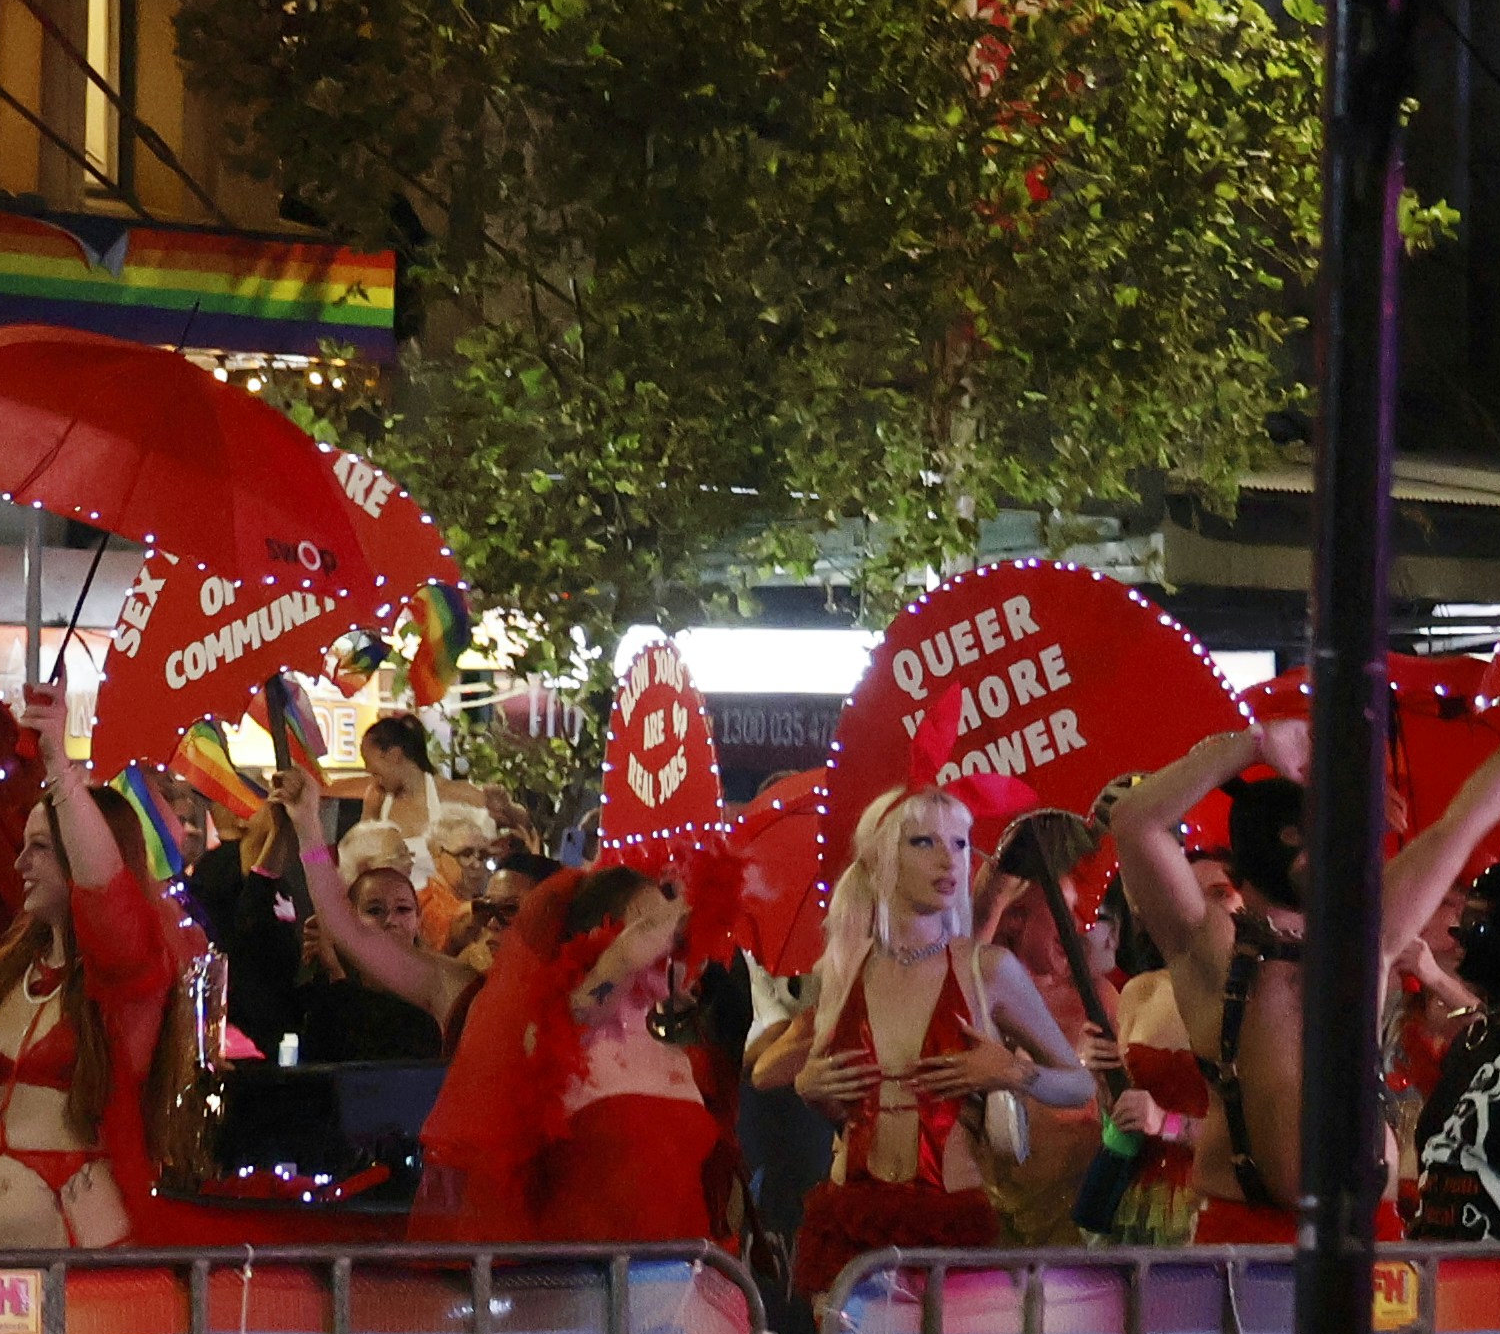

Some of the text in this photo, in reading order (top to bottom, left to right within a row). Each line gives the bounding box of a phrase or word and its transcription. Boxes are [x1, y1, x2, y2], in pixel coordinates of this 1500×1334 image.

[332, 452, 396, 519] ARE
[113, 567, 166, 659] SEX
[164, 590, 336, 690] COMMUNI
[892, 594, 1041, 701] QUEER
[643, 708, 666, 751] ARE
[627, 744, 688, 809] REAL JOBS
